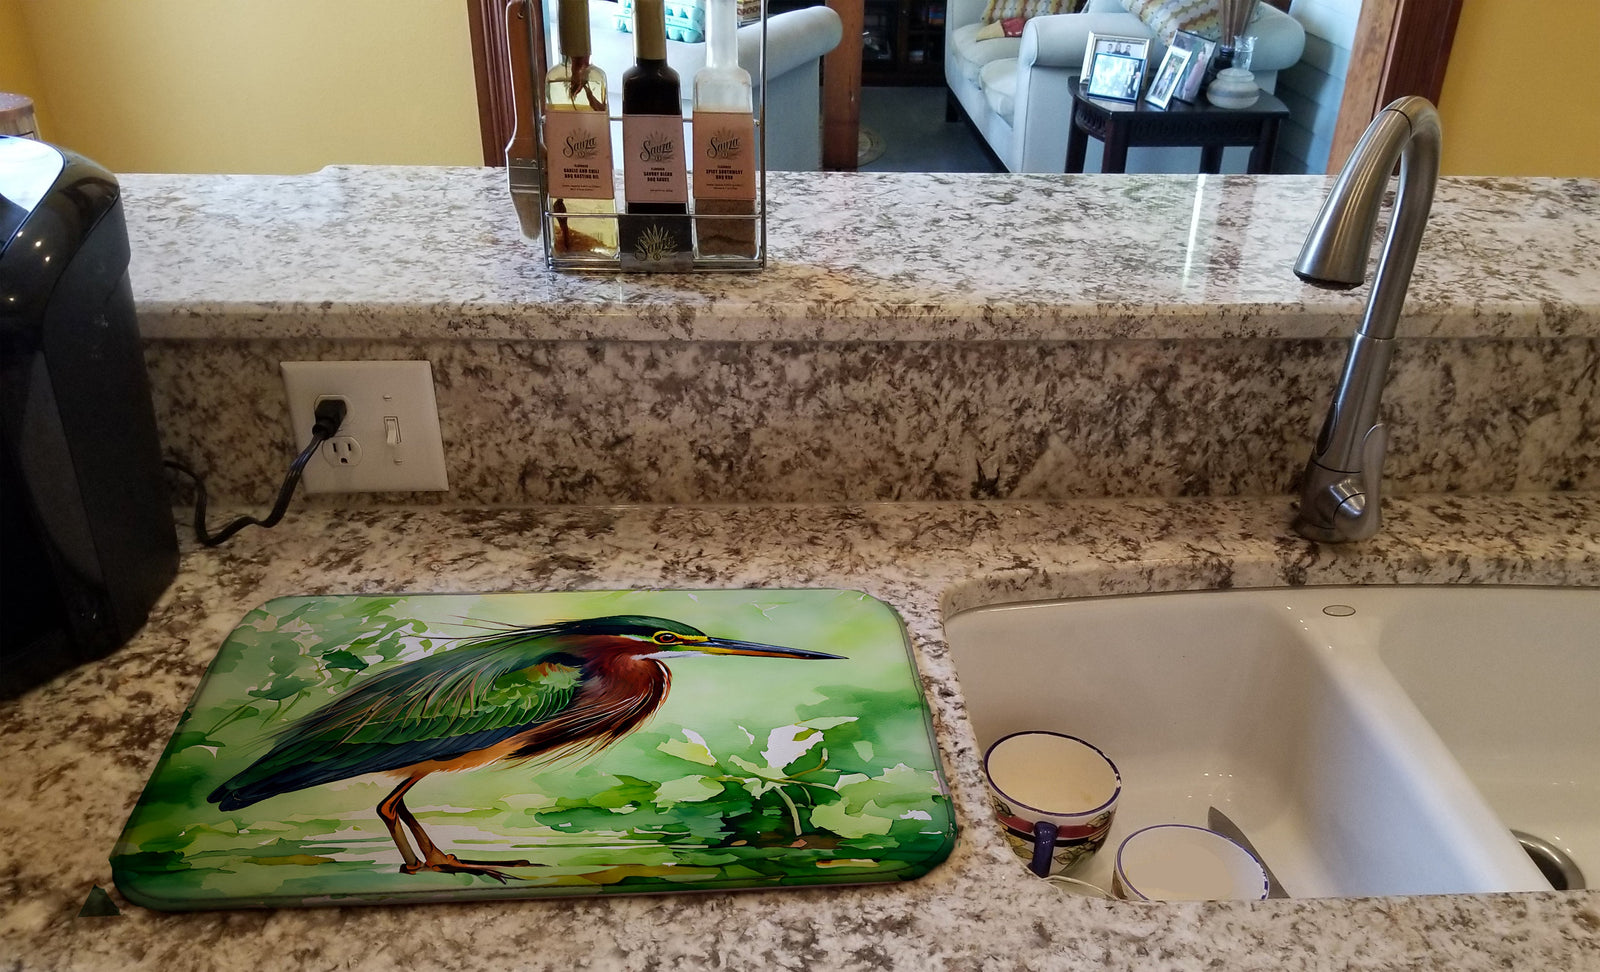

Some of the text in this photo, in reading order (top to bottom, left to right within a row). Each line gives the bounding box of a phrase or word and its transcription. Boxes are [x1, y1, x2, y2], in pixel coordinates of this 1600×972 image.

[563, 136, 597, 158] Sauza
[640, 140, 673, 162] Sauza
[707, 137, 739, 159] Sauza
